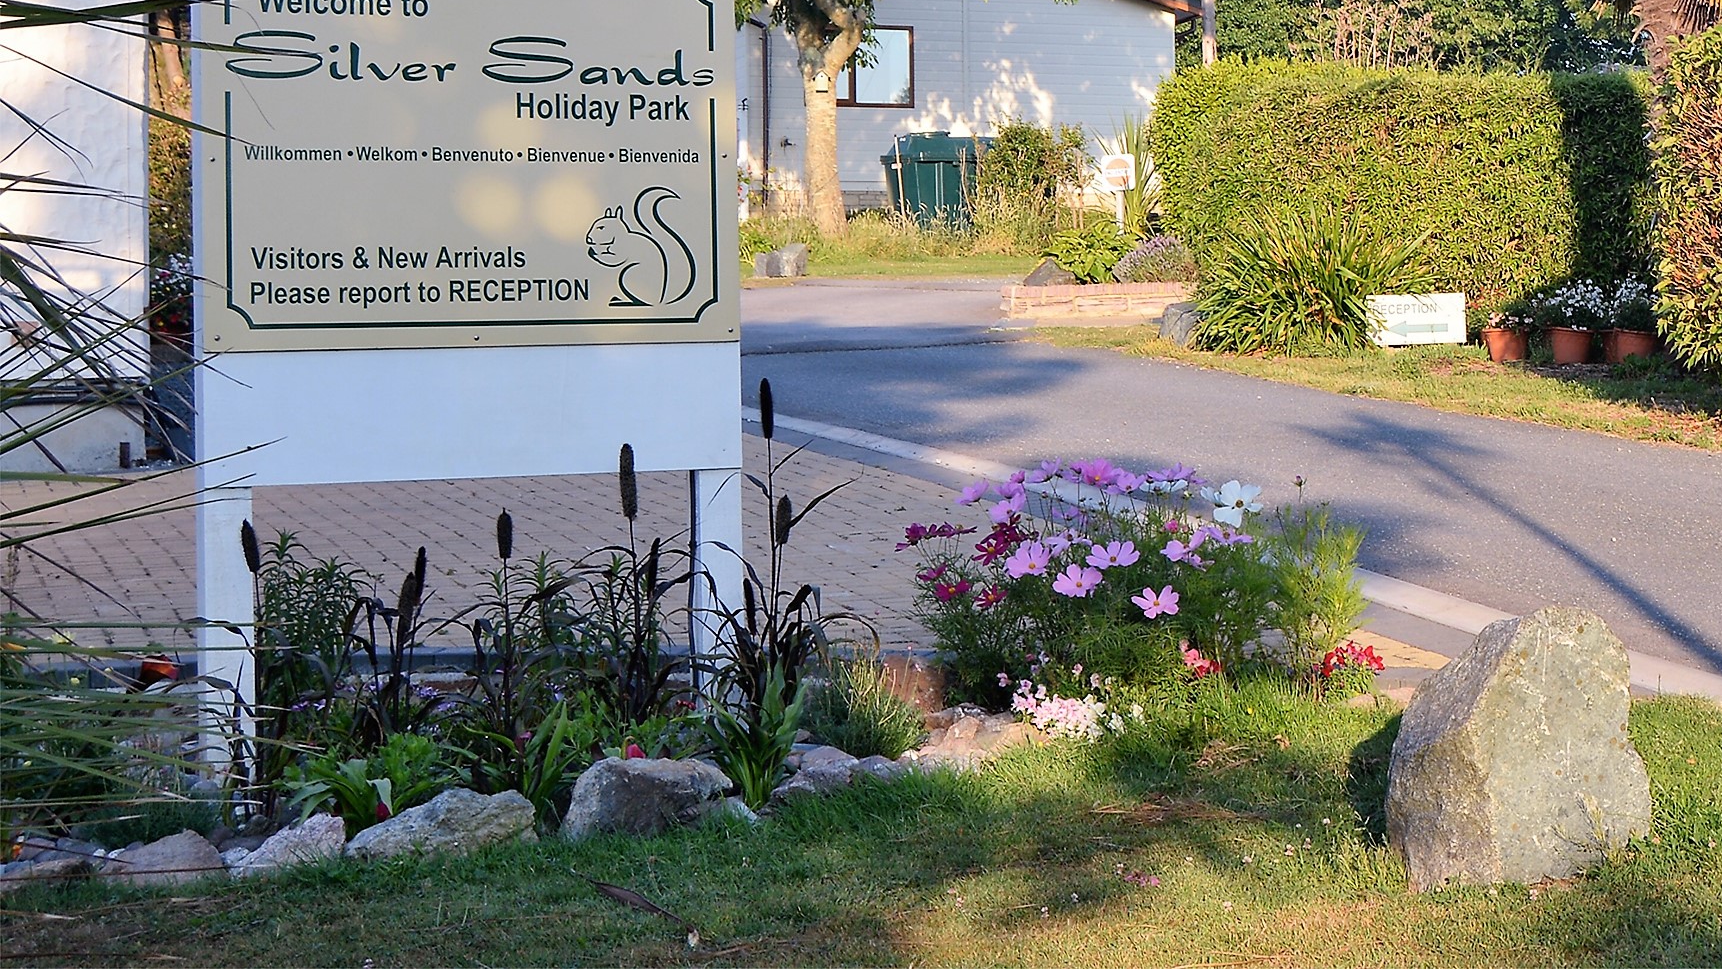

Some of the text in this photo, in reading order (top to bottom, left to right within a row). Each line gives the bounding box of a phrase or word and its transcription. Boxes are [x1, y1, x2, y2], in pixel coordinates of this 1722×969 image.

[226, 30, 715, 87] Silver Sands
[515, 92, 690, 127] Holiday Park
[244, 146, 700, 164] Willkommen Welkom Benvenuto Bienvenue Bienvenida
[251, 246, 526, 270] Visitors & New Arrivals
[250, 279, 590, 310] Please report to RECEPTION
[1372, 303, 1437, 315] RECEPTION
